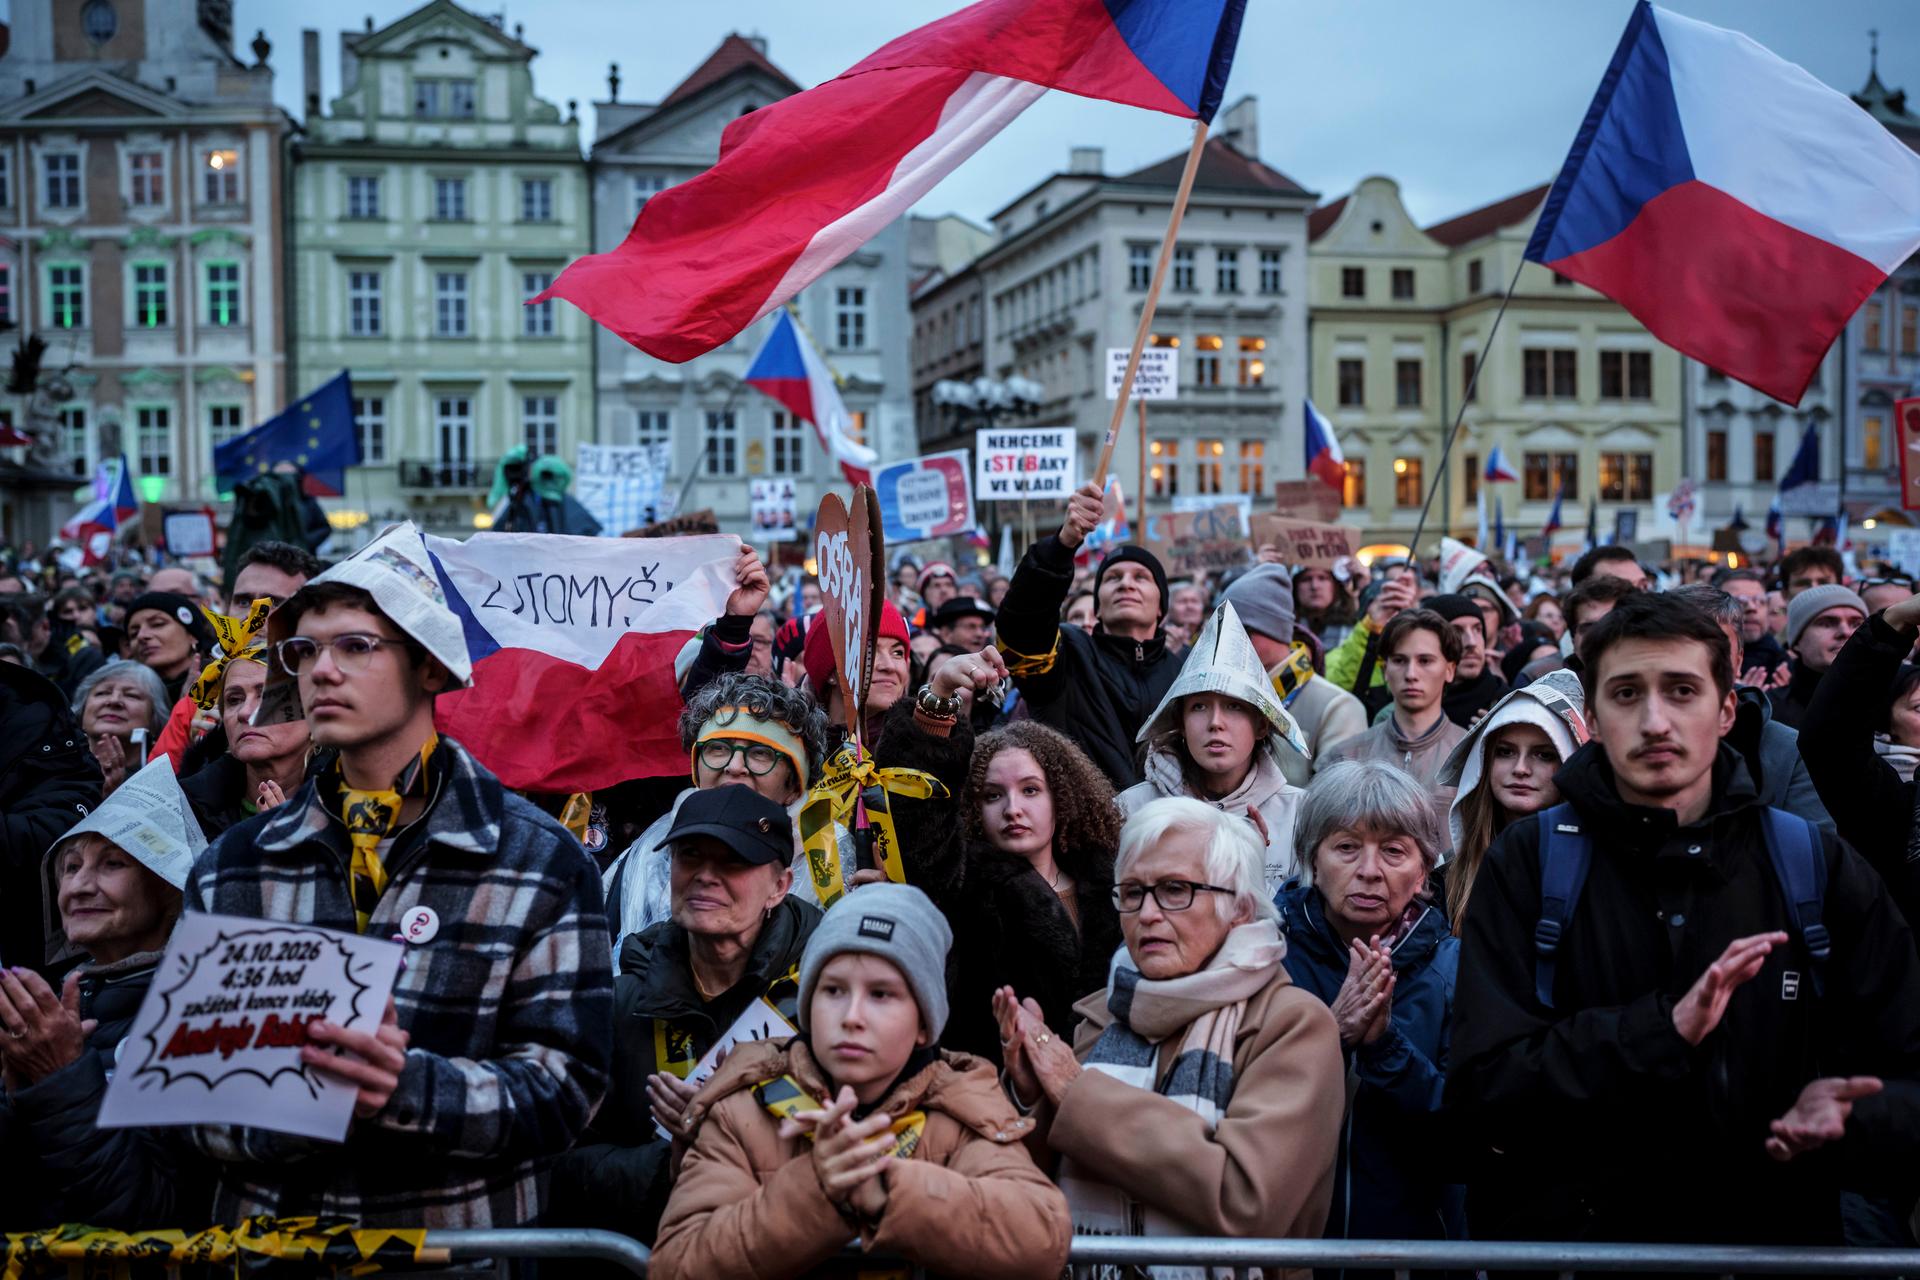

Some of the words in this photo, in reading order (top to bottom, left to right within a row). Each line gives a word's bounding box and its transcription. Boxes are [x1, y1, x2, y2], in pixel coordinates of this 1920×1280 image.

[991, 480, 1008, 492] VE
[481, 562, 673, 628] LITOMYŠ
[219, 941, 322, 966] 24.10.2026
[220, 968, 265, 989] 4:36
[267, 965, 306, 987] hod
[245, 990, 288, 1010] konce
